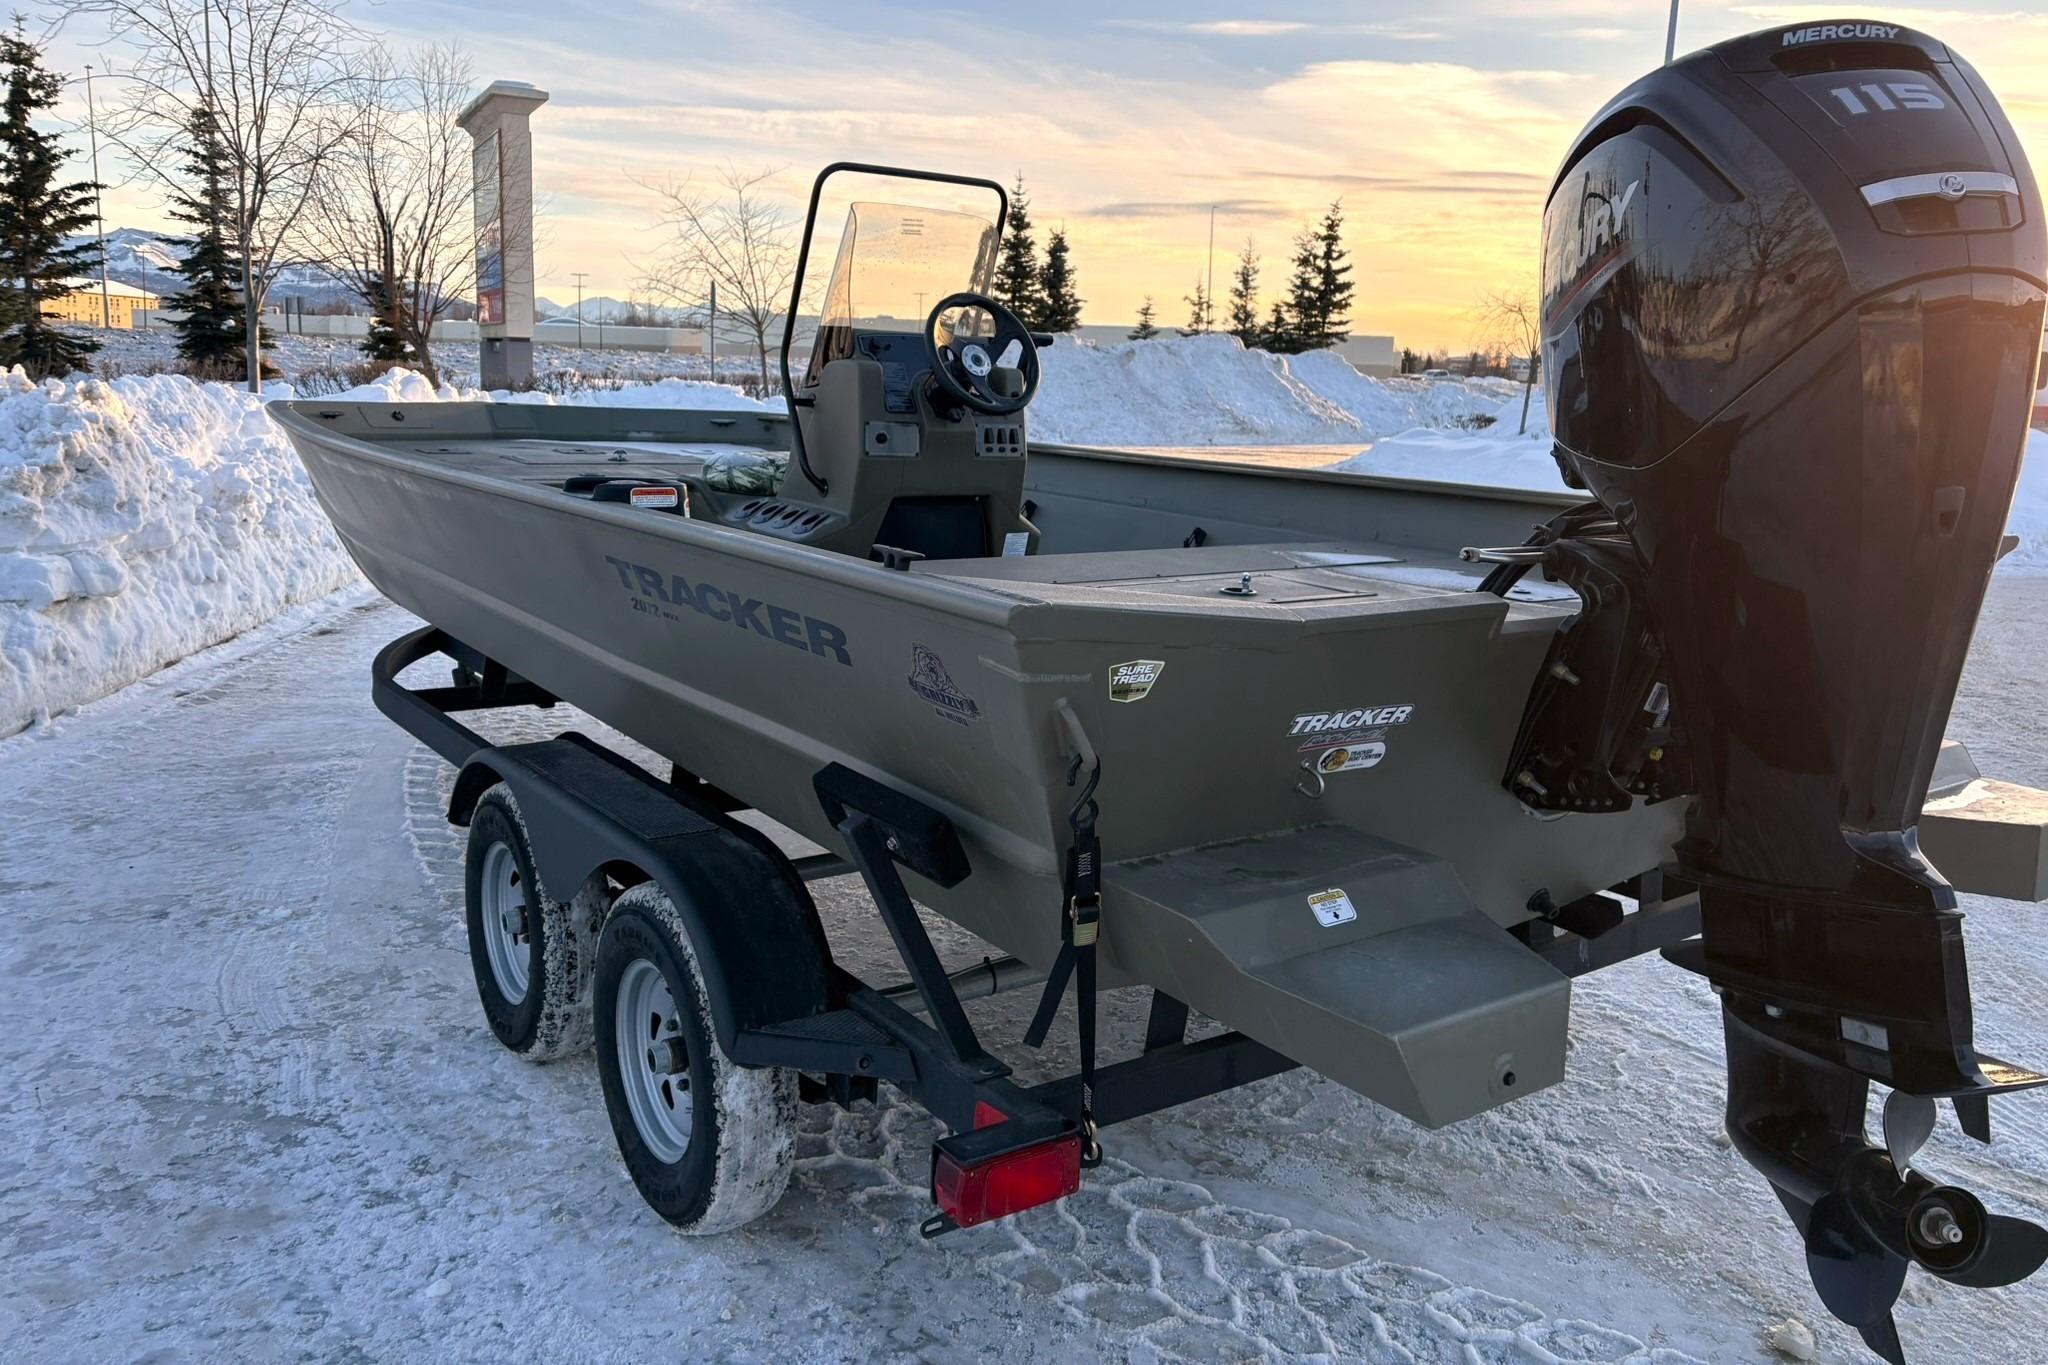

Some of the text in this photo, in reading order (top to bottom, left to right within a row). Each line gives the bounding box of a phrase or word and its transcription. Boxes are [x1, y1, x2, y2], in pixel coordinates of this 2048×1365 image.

[1782, 25, 1899, 46] MERCURY
[1830, 83, 1945, 116] 115
[605, 556, 853, 667] TRACKER
[1112, 674, 1154, 685] TREAD
[1117, 664, 1154, 676] SURE
[1290, 705, 1413, 734] TRACKER
